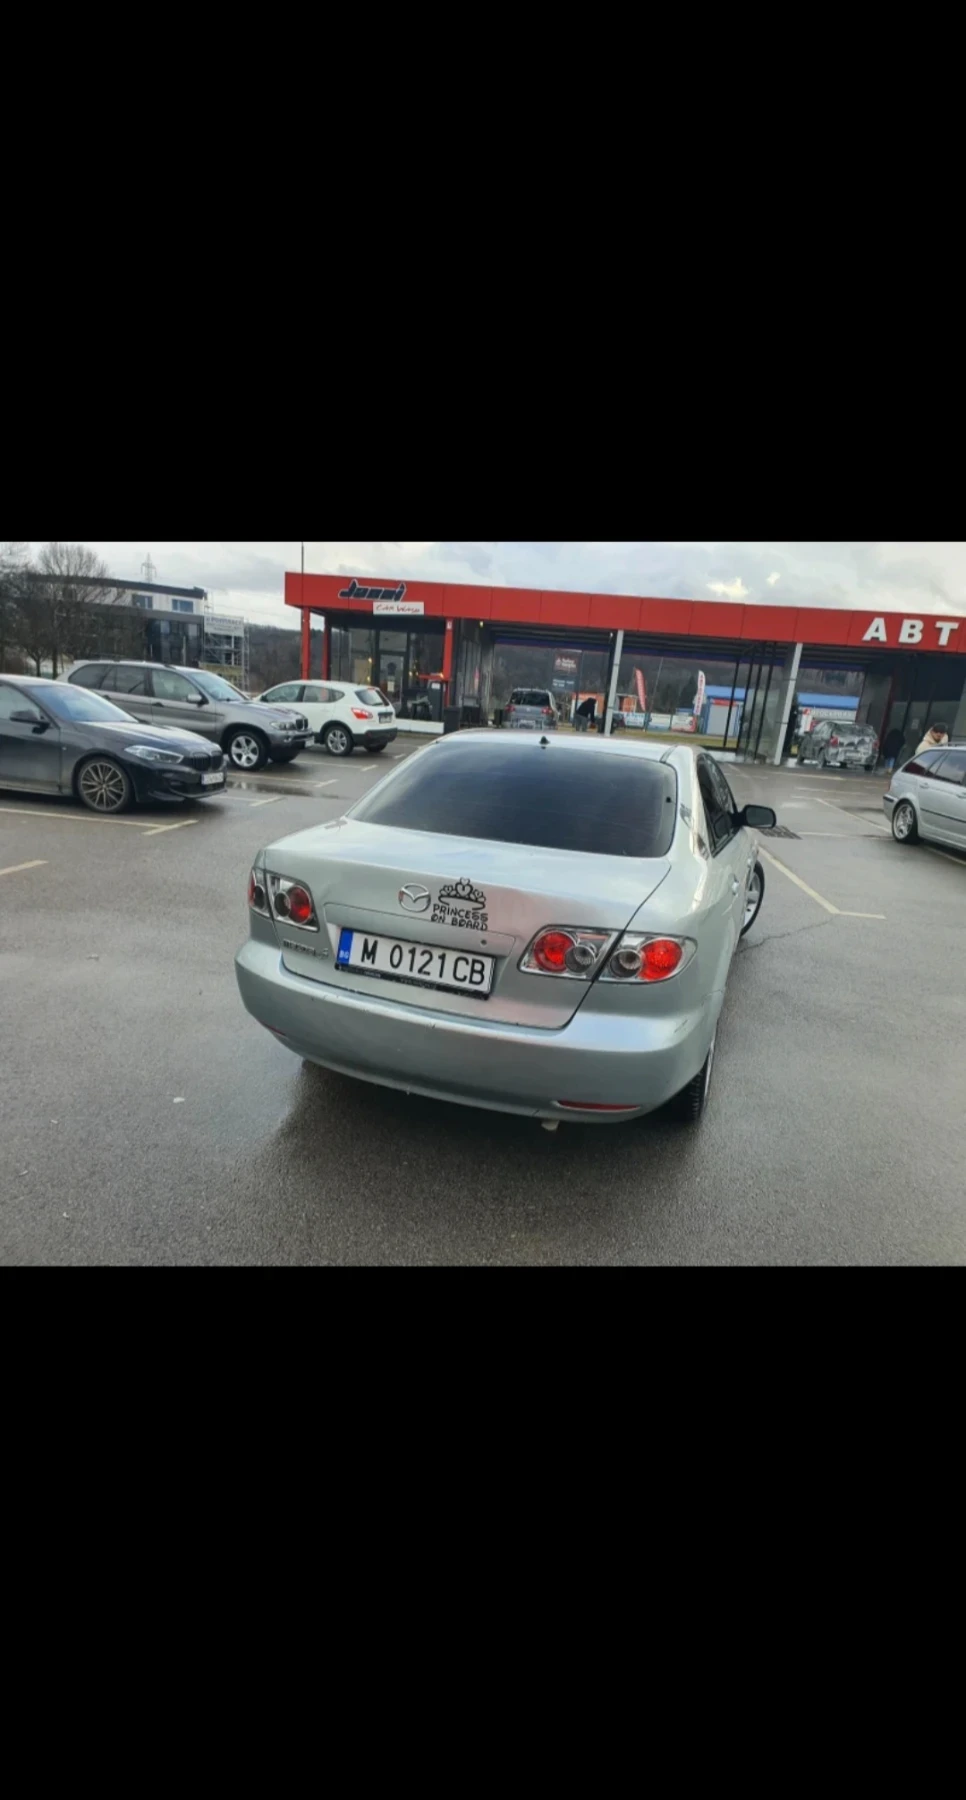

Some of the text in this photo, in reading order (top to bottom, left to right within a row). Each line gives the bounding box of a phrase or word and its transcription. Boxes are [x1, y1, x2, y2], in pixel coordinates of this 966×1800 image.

[430, 913, 488, 931] ON BOARD
[433, 903, 489, 923] PRINCESS
[361, 938, 378, 965] M
